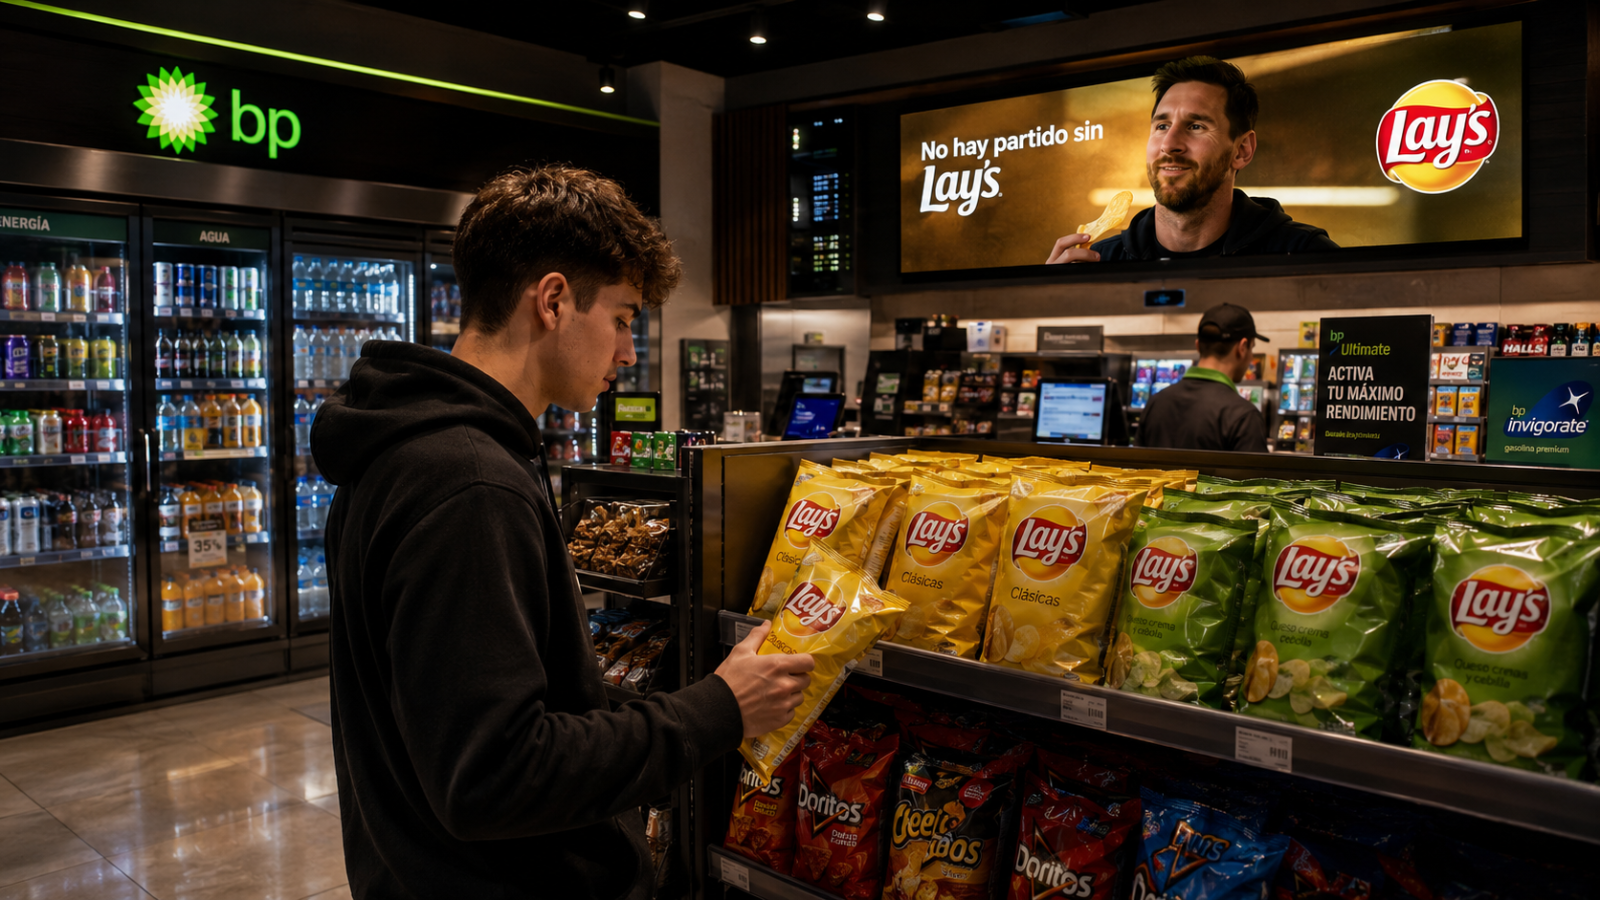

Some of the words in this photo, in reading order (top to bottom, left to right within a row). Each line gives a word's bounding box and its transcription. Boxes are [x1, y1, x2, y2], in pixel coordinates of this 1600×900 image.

[232, 89, 301, 159] bp
[921, 141, 948, 161] No
[953, 137, 989, 160] hay
[993, 124, 1068, 158] partido
[1073, 120, 1104, 142] sin
[1385, 103, 1491, 169] Lay's
[920, 159, 1001, 217] Lay's
[200, 230, 230, 244] AGUA
[1330, 329, 1344, 343] bp
[1341, 342, 1391, 356] Ultimate
[1503, 343, 1544, 354] HALLS
[1327, 366, 1374, 381] ACTIVA
[1327, 385, 1344, 400] TU
[1347, 383, 1404, 401] MÁXIMO
[1326, 404, 1416, 422] RENDIMIENTO
[1512, 405, 1526, 417] bp
[1507, 417, 1587, 436] invigorate
[1504, 444, 1535, 453] gasolina
[787, 500, 838, 537] Lay's
[908, 512, 966, 554] Lay's
[1014, 518, 1083, 566] Lay's
[901, 571, 944, 590] Clásicas
[1133, 548, 1194, 594] Lay's
[1276, 547, 1355, 597] Lay's
[786, 583, 841, 626] Lay's
[1010, 586, 1060, 607] Clásicas
[1455, 581, 1546, 635] Lay's
[1454, 658, 1489, 673] Queso
[1465, 674, 1472, 684] y
[798, 783, 862, 823] Doritos
[1015, 843, 1093, 898] Doritos
